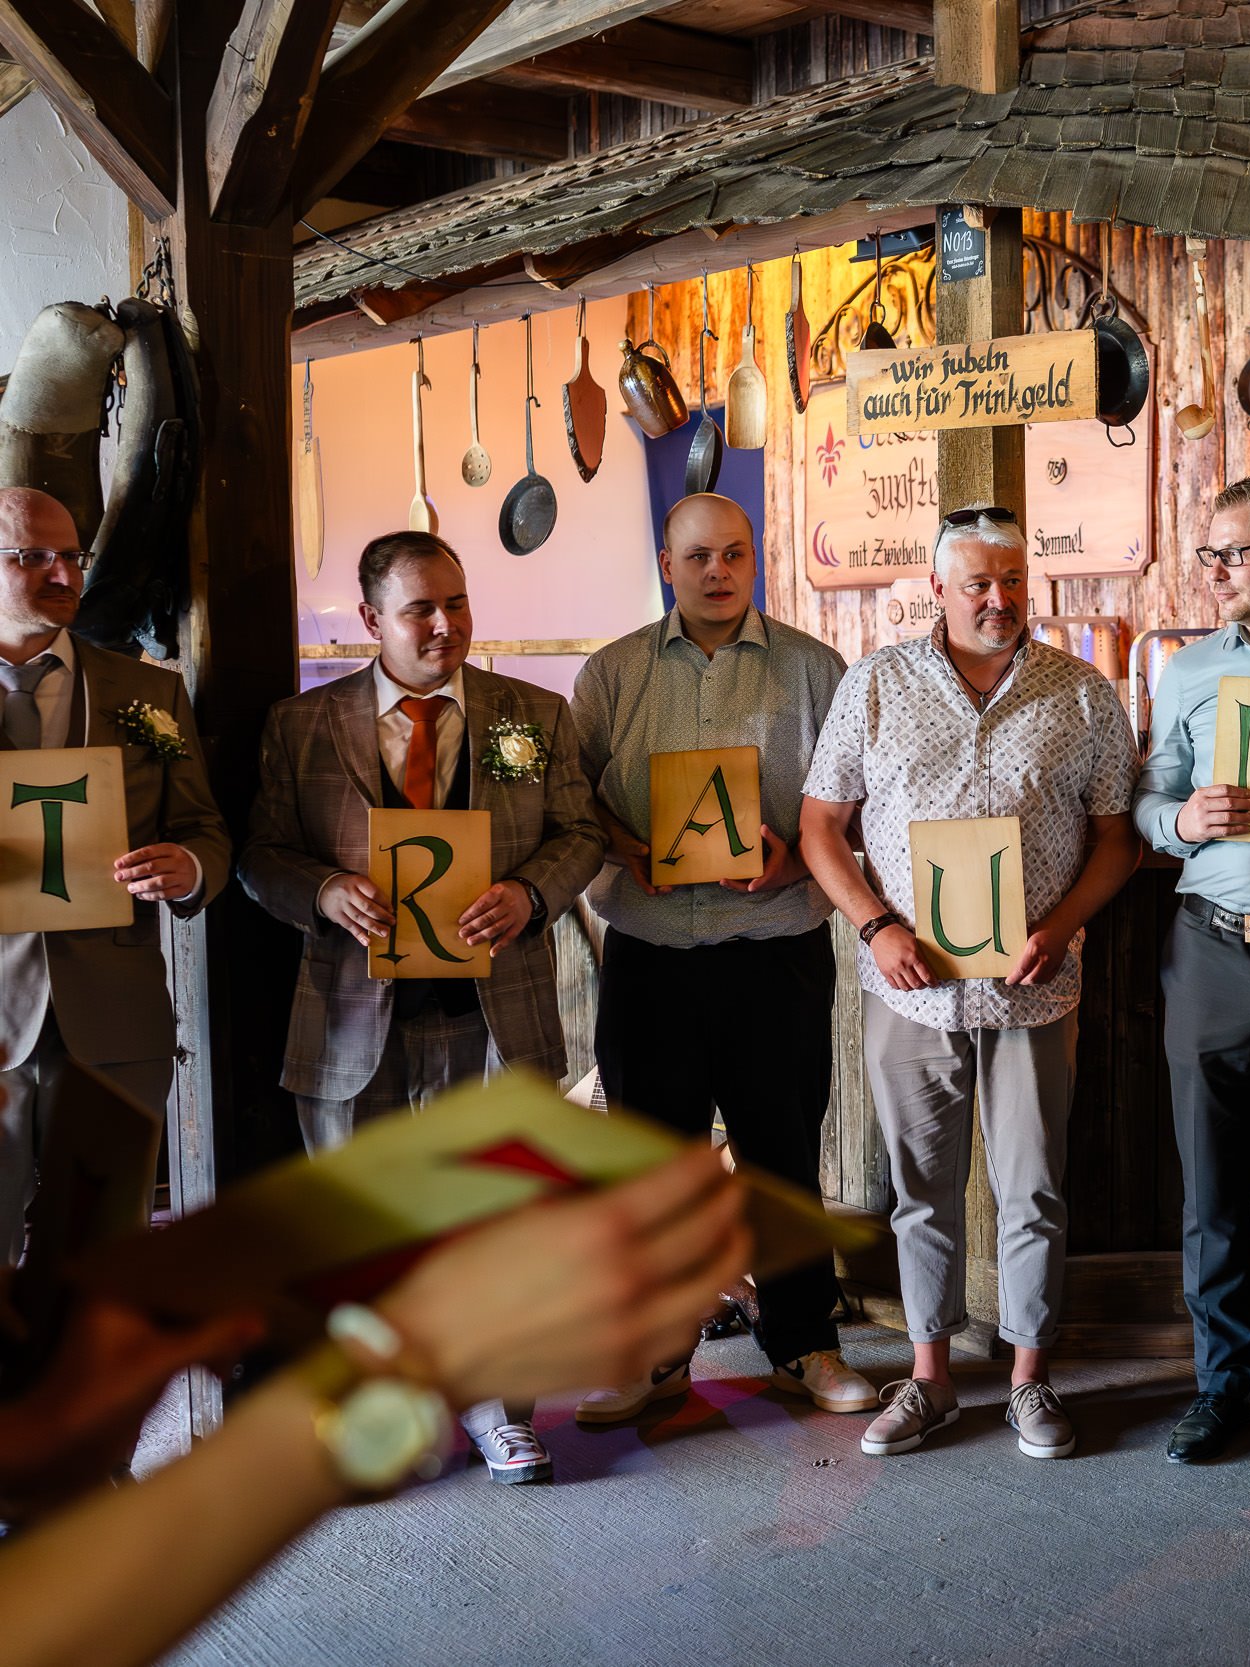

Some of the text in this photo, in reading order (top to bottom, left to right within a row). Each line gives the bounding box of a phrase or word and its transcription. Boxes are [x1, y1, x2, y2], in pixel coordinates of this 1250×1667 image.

[863, 358, 1075, 423] auch für Trinkgeld
[939, 342, 1010, 386] jubeln
[848, 536, 927, 569] mit Zwiebeln
[1033, 522, 1085, 558] Semmel
[12, 774, 89, 903] T
[658, 764, 754, 867] A
[376, 835, 474, 965] R
[926, 846, 1010, 957] U
